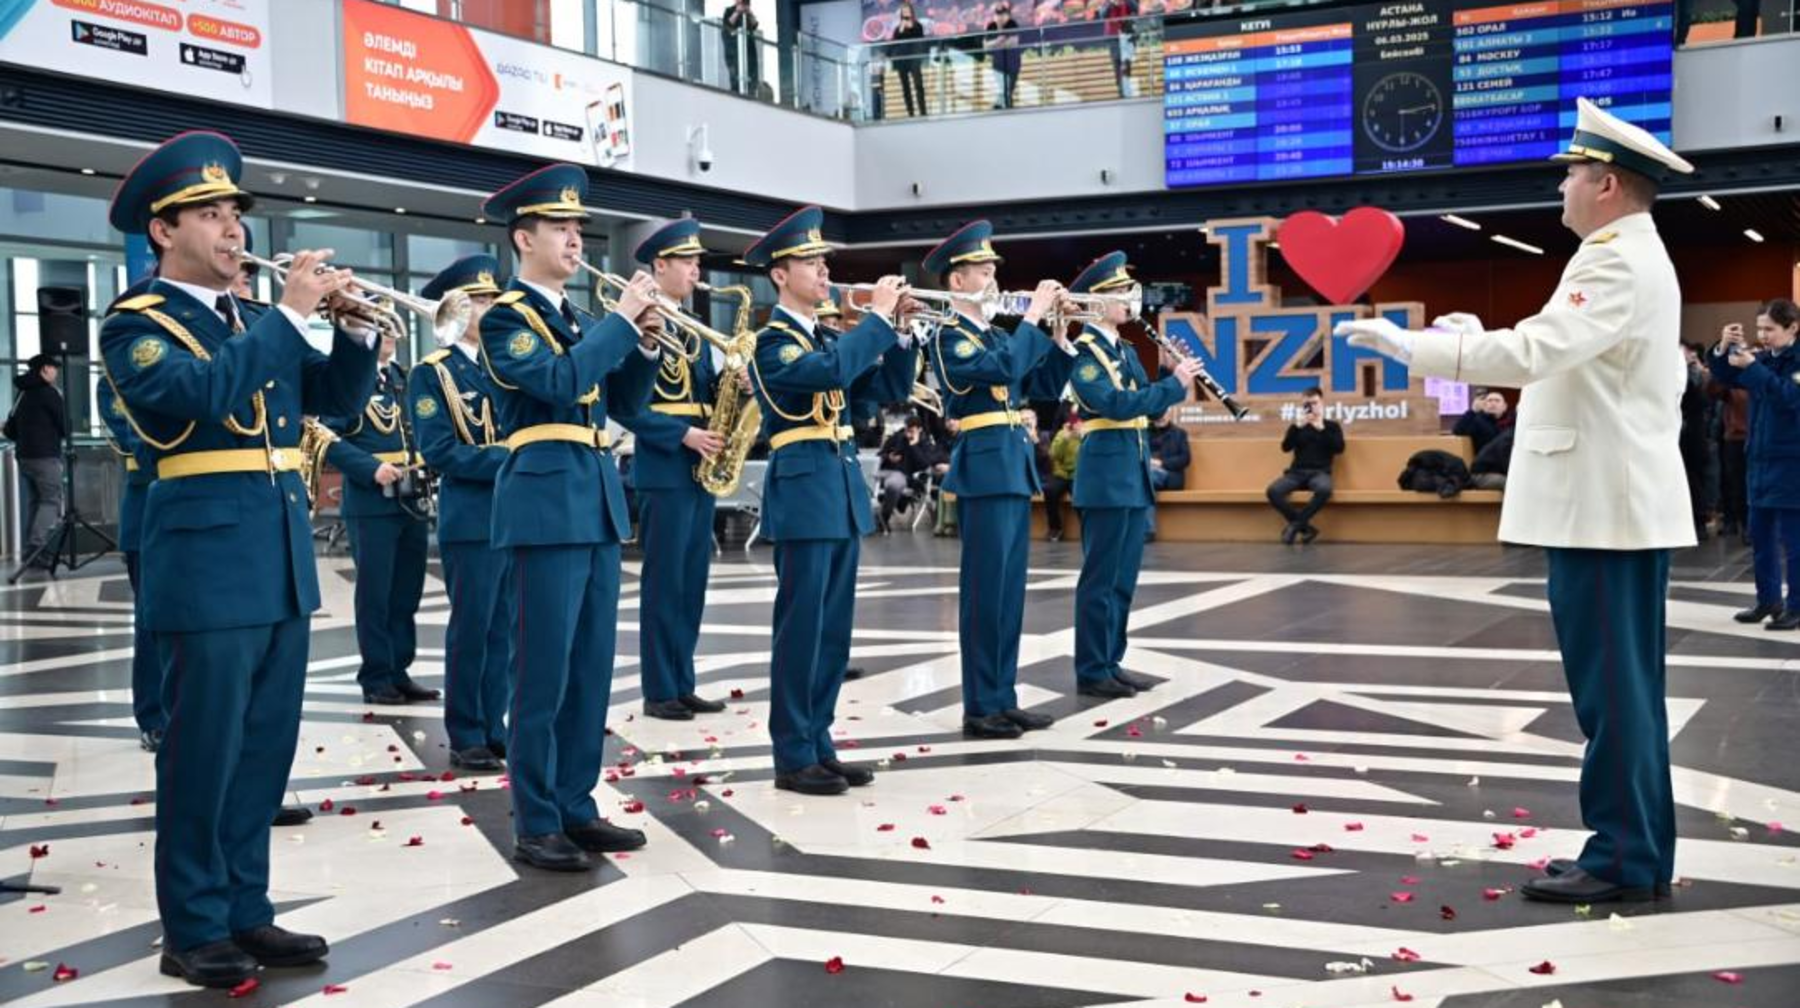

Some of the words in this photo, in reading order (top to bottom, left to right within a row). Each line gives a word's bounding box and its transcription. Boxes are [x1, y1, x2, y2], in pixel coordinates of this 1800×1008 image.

[1380, 3, 1424, 16] АСТАНА
[220, 25, 256, 42] АВТОР
[1374, 31, 1429, 45] 06.03.2025
[1477, 23, 1507, 34] ОРАЛ
[363, 31, 417, 59] ӘЛЕМДІ
[364, 57, 404, 79] КІТАП
[405, 67, 464, 93] АРҚЫЛЫ
[365, 82, 434, 110] ТАНЫҢЫЗ
[1161, 305, 1416, 397] NZH
[1280, 400, 1409, 425] #rlyzhol
